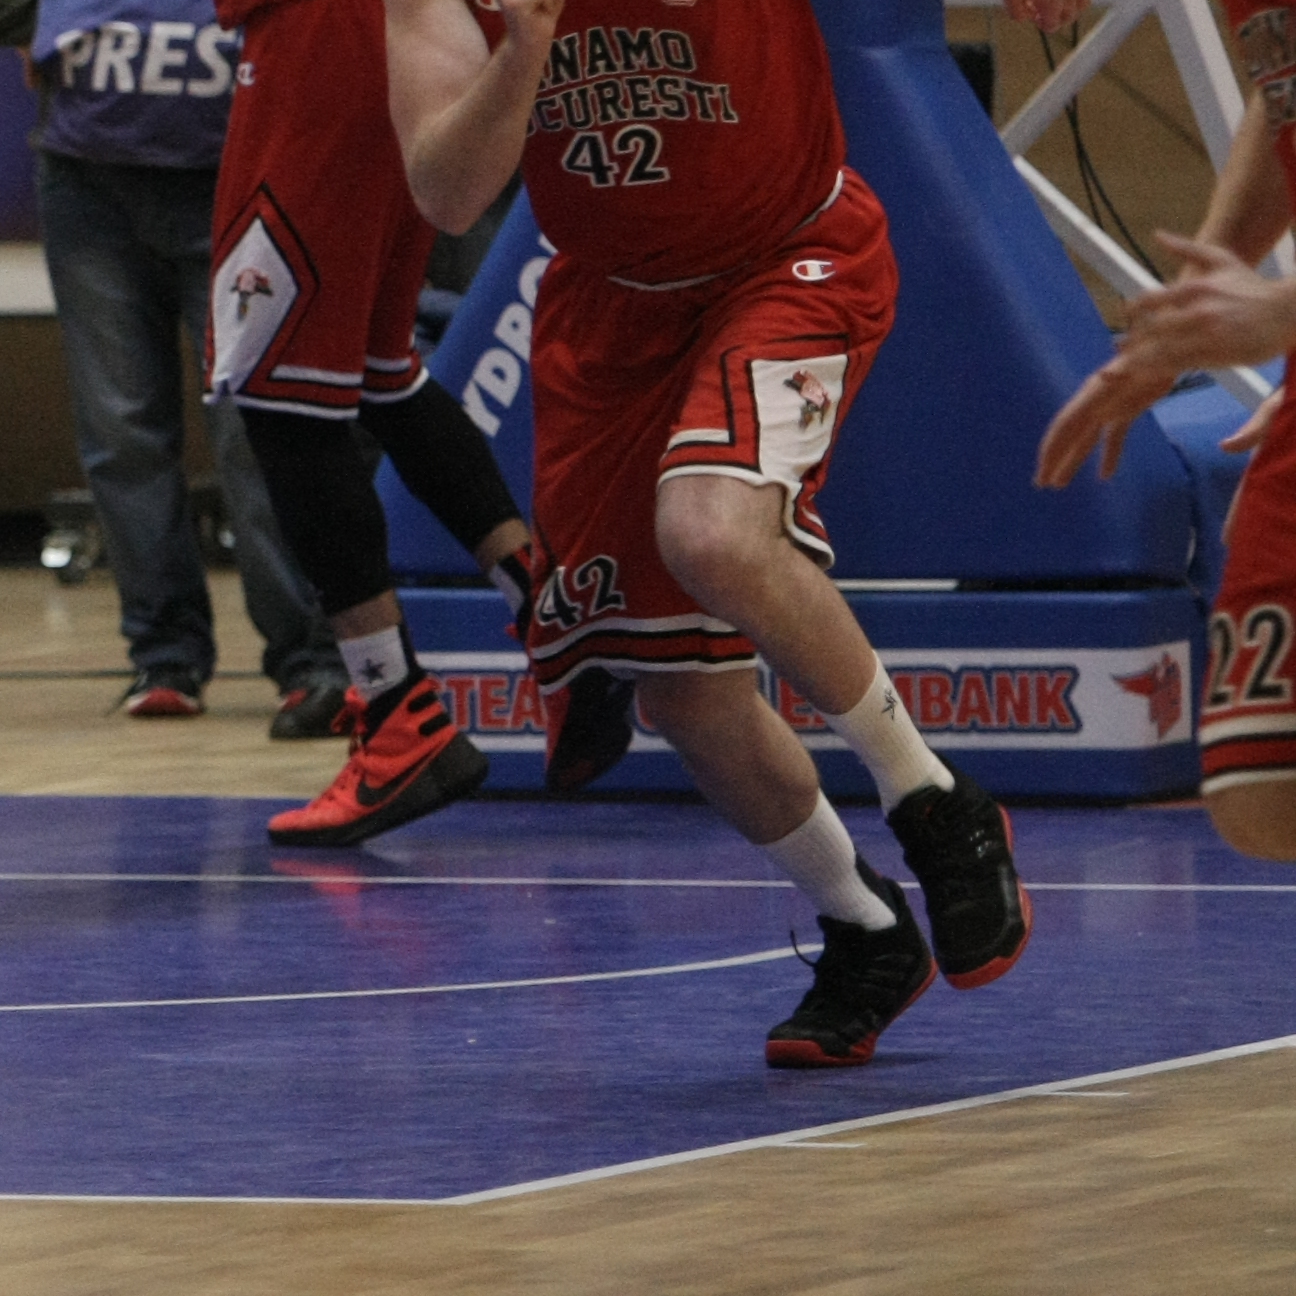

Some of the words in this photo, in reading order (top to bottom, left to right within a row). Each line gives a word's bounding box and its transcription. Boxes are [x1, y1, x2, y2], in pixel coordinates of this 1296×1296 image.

[55, 20, 243, 98] PRES
[538, 26, 698, 90] NAMO
[526, 76, 740, 138] CURESTI
[562, 124, 671, 188] 42
[535, 554, 626, 630] 42
[1201, 604, 1293, 714] 22
